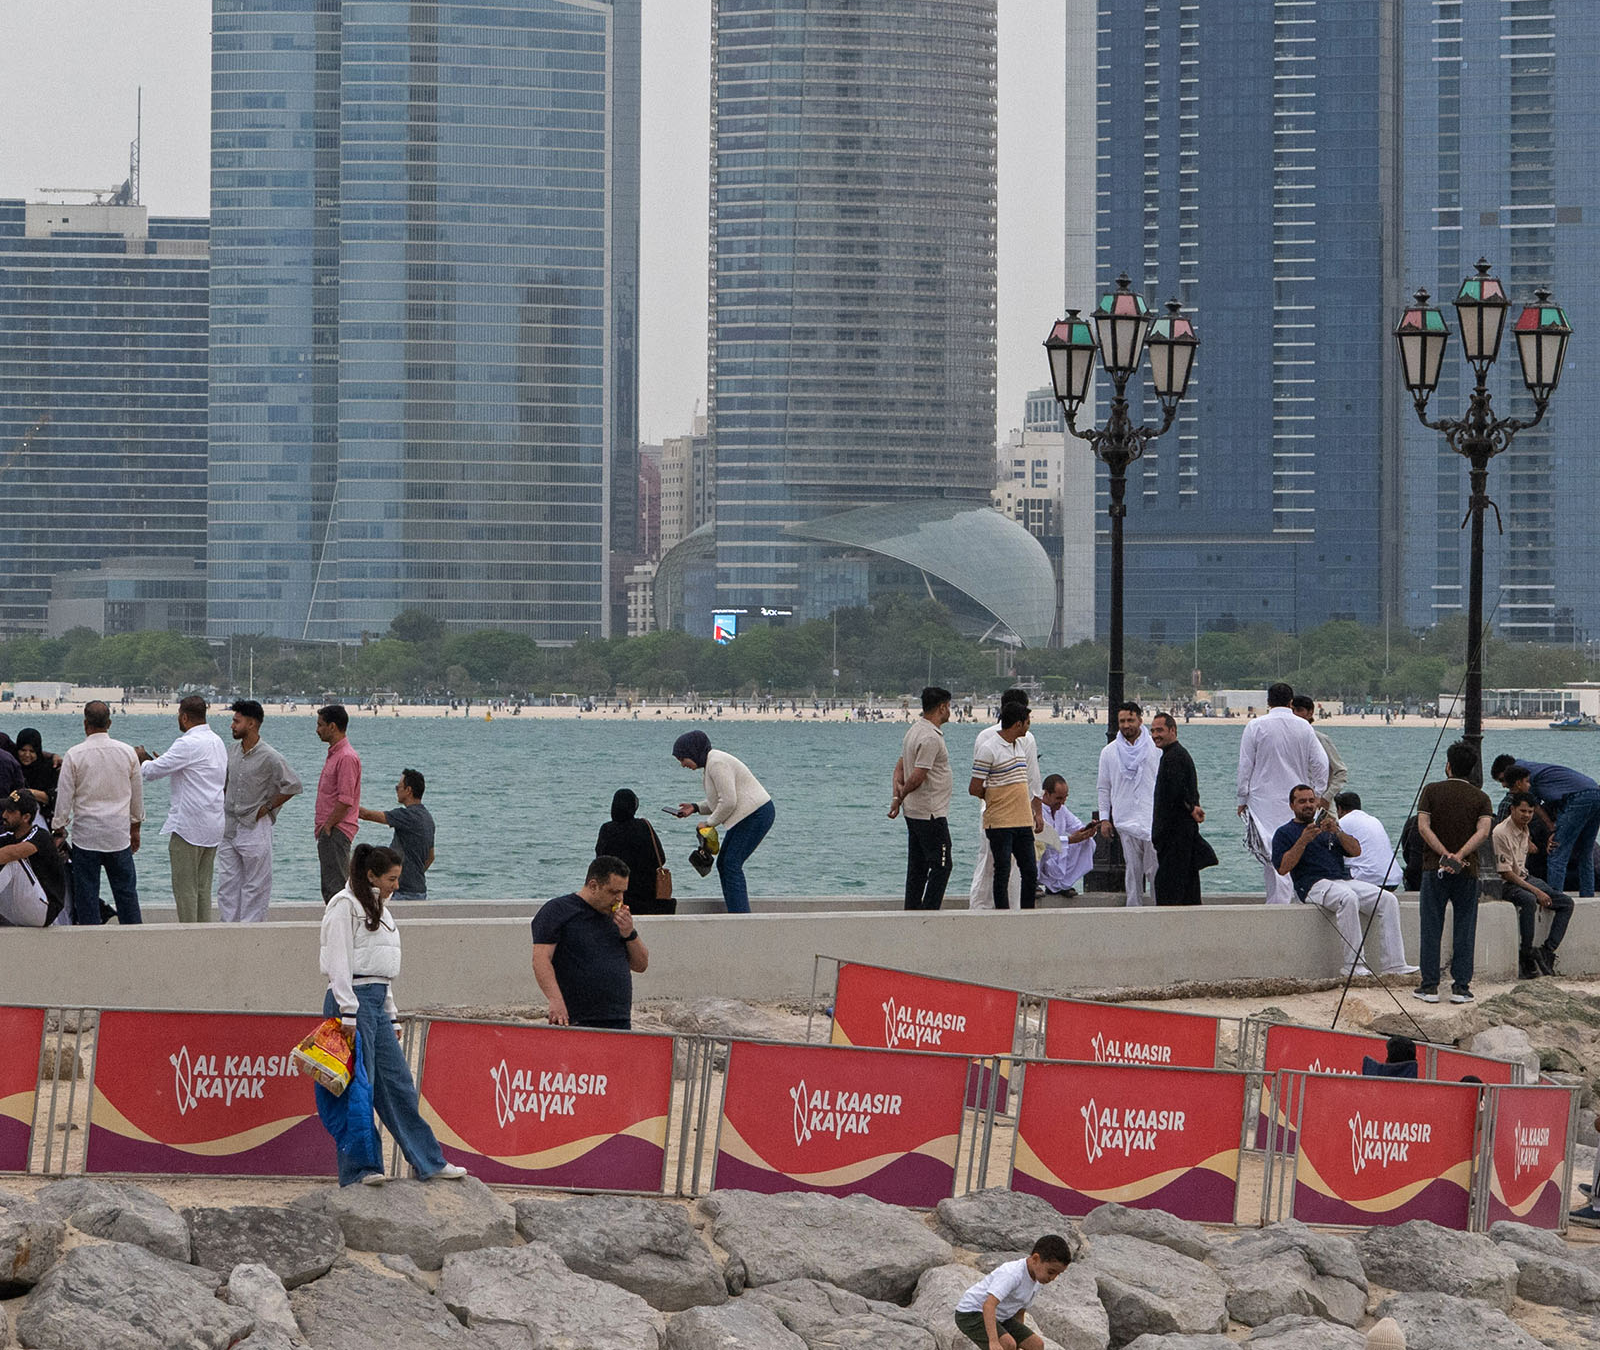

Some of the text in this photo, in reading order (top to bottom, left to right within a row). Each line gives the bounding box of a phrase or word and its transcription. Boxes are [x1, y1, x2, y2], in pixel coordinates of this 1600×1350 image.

[897, 1006, 966, 1032] AL KAASIR
[897, 1023, 942, 1047] KAYAK
[1106, 1040, 1121, 1057] AL
[1124, 1042, 1171, 1063] KAASIR
[192, 1055, 219, 1076] AL
[195, 1078, 265, 1107] KAYAK
[511, 1070, 608, 1095] AL KAASIR
[513, 1092, 576, 1121] KAYAK
[809, 1090, 902, 1115] AL KAASIR
[810, 1111, 871, 1140] KAYAK
[1099, 1108, 1185, 1131] AL KAASIR
[1363, 1120, 1431, 1143] AL KAASIR
[1101, 1129, 1157, 1156] KAYAK
[1520, 1127, 1550, 1147] AL KAASIR
[1364, 1141, 1409, 1168] KAYAK
[1520, 1147, 1540, 1172] KAYAK
